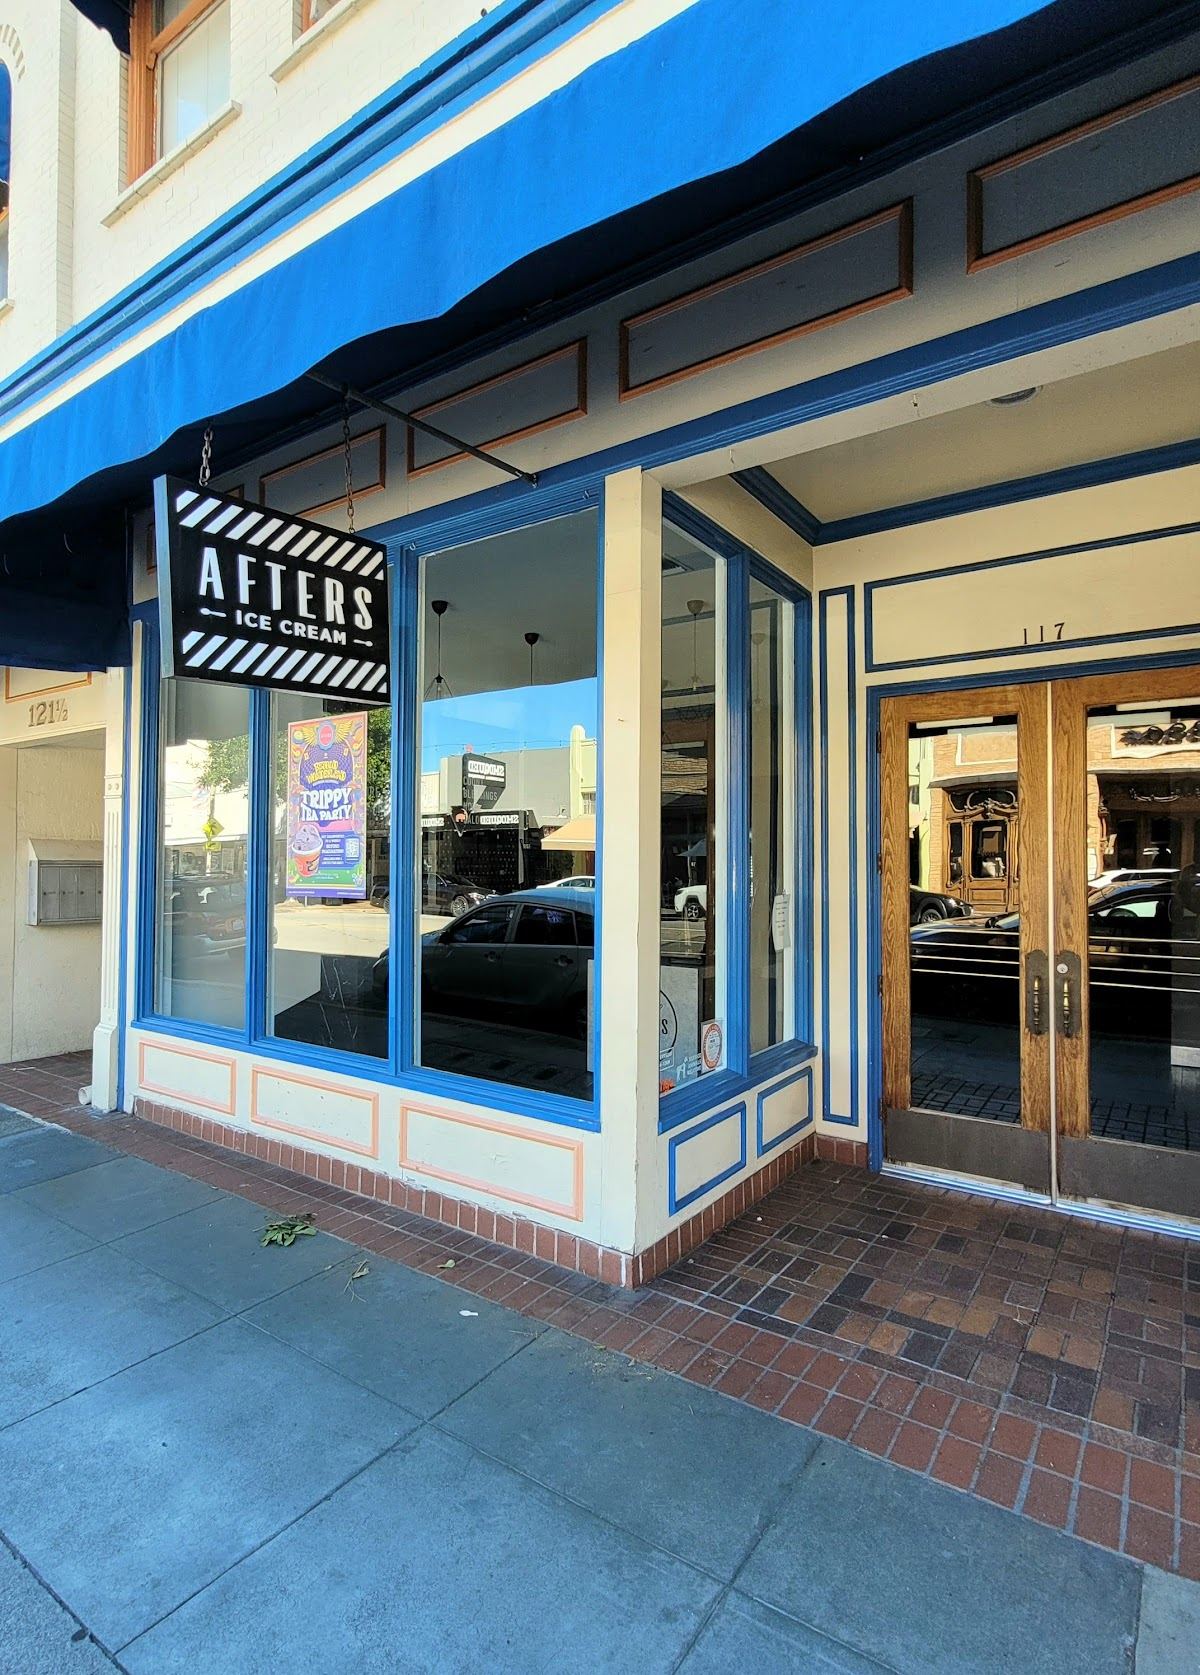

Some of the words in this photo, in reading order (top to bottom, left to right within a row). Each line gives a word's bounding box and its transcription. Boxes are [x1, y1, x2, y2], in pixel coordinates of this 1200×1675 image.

[199, 547, 373, 630] AFTERS
[236, 609, 272, 631] ICE
[279, 619, 347, 646] CREAM
[1023, 622, 1065, 645] 117
[300, 787, 352, 809] TRIPPY
[300, 803, 319, 821] TEA
[319, 804, 353, 821] PARTY
